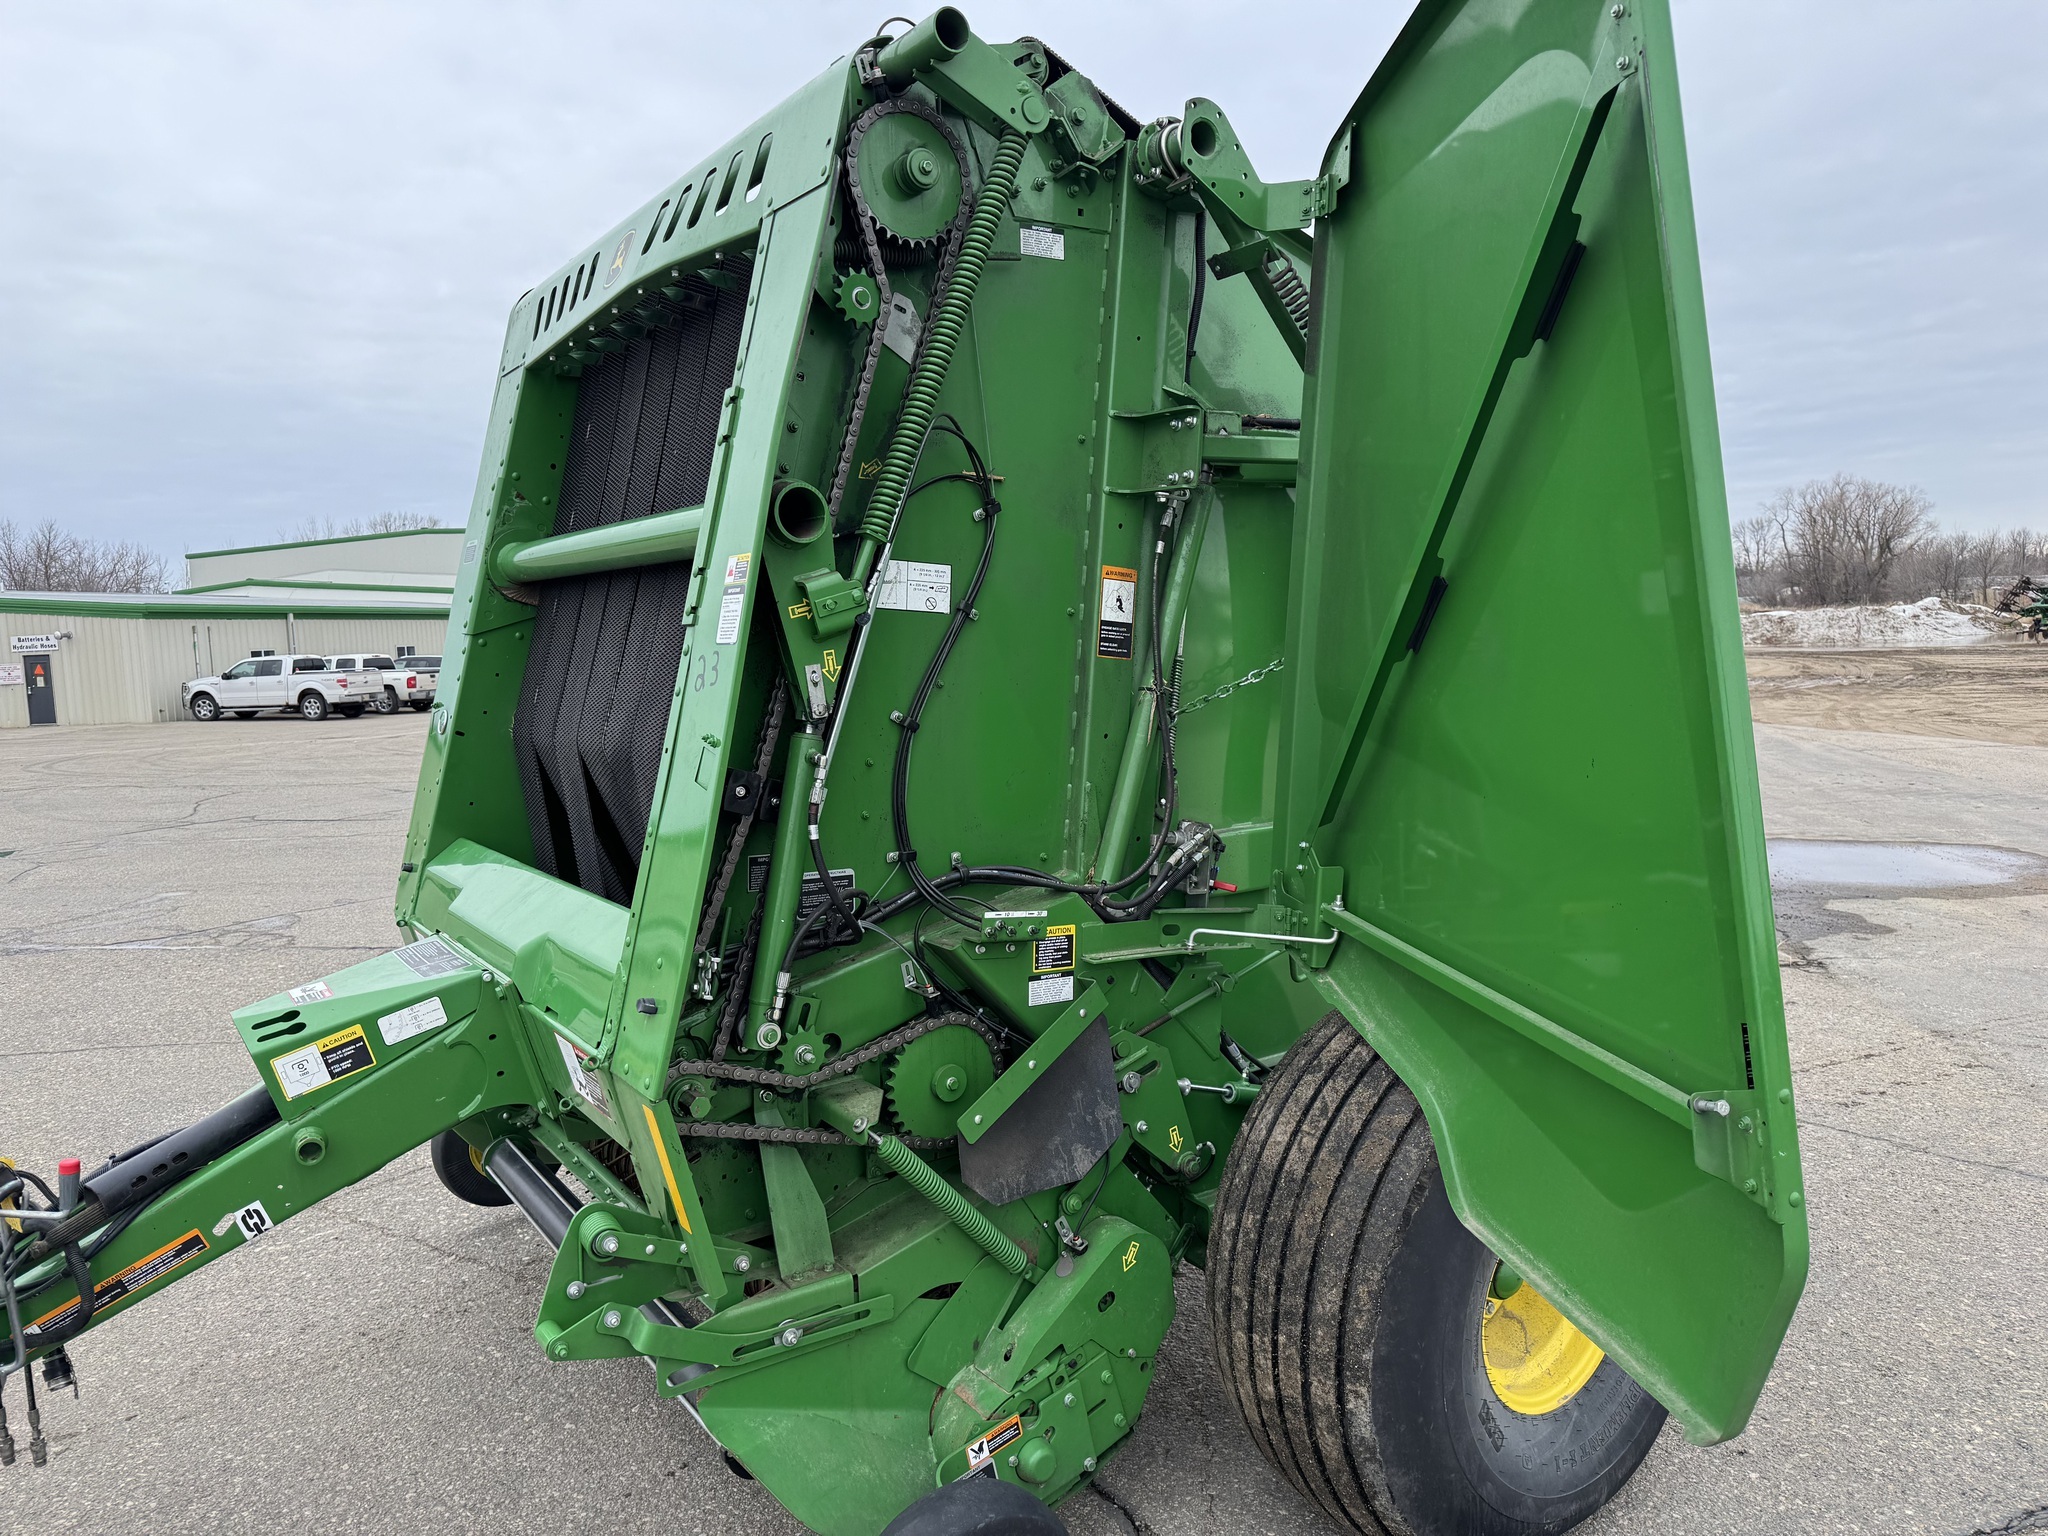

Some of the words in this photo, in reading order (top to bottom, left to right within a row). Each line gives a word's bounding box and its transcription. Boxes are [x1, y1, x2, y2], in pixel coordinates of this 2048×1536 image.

[1110, 571, 1133, 579] WARNING
[1047, 926, 1072, 935] AUTION
[328, 1031, 357, 1046] CAUTION
[104, 1265, 137, 1286] WARNING
